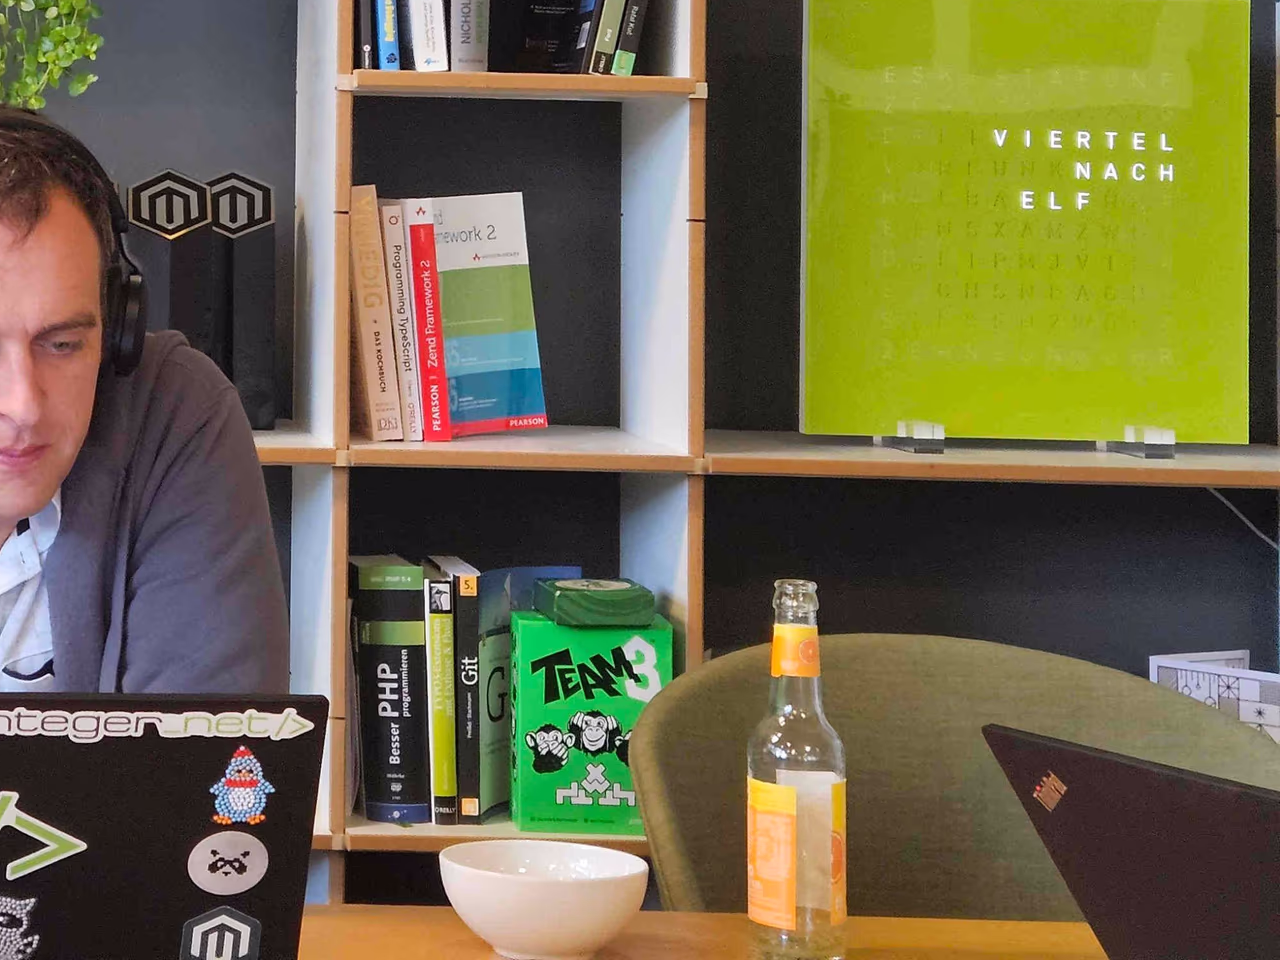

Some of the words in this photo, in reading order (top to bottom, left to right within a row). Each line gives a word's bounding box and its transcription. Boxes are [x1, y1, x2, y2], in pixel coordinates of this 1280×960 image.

[992, 127, 1174, 152] VIERTEL
[1074, 163, 1175, 182] NACH
[1020, 191, 1091, 210] ELF
[486, 224, 497, 241] 2
[420, 259, 430, 268] 2
[392, 244, 405, 315] Programming
[422, 272, 437, 340] Framework
[373, 331, 381, 348] DAS
[398, 316, 412, 373] TypeScript
[427, 341, 438, 368] Zend
[374, 350, 386, 393] KOCHBUCH
[407, 403, 416, 434] O'REILLY
[429, 383, 441, 431] PEARSON
[509, 417, 544, 428] PEARSON
[400, 648, 412, 718] programmieren
[461, 656, 478, 686] Git
[530, 645, 643, 705] TEAM
[622, 635, 663, 704] 3
[376, 662, 400, 718] PHP
[388, 722, 401, 765] Besser
